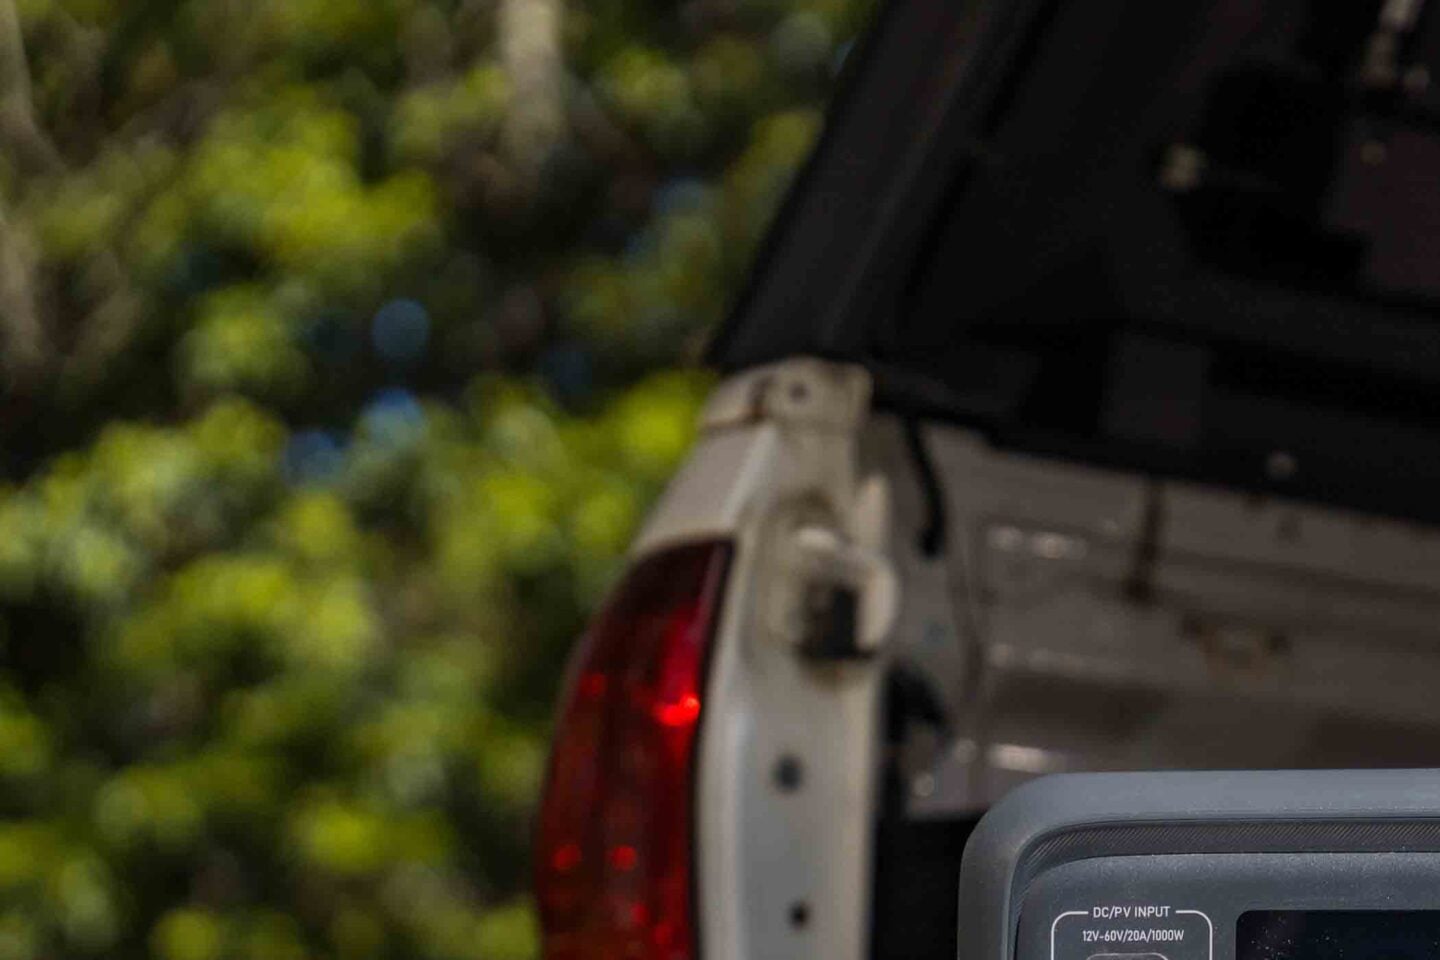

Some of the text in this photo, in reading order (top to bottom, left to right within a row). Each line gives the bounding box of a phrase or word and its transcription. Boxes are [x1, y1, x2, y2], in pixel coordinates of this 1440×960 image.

[1093, 905, 1171, 920] DC/PV INPUT
[1082, 928, 1185, 944] 12V-60V/20A/1000W
